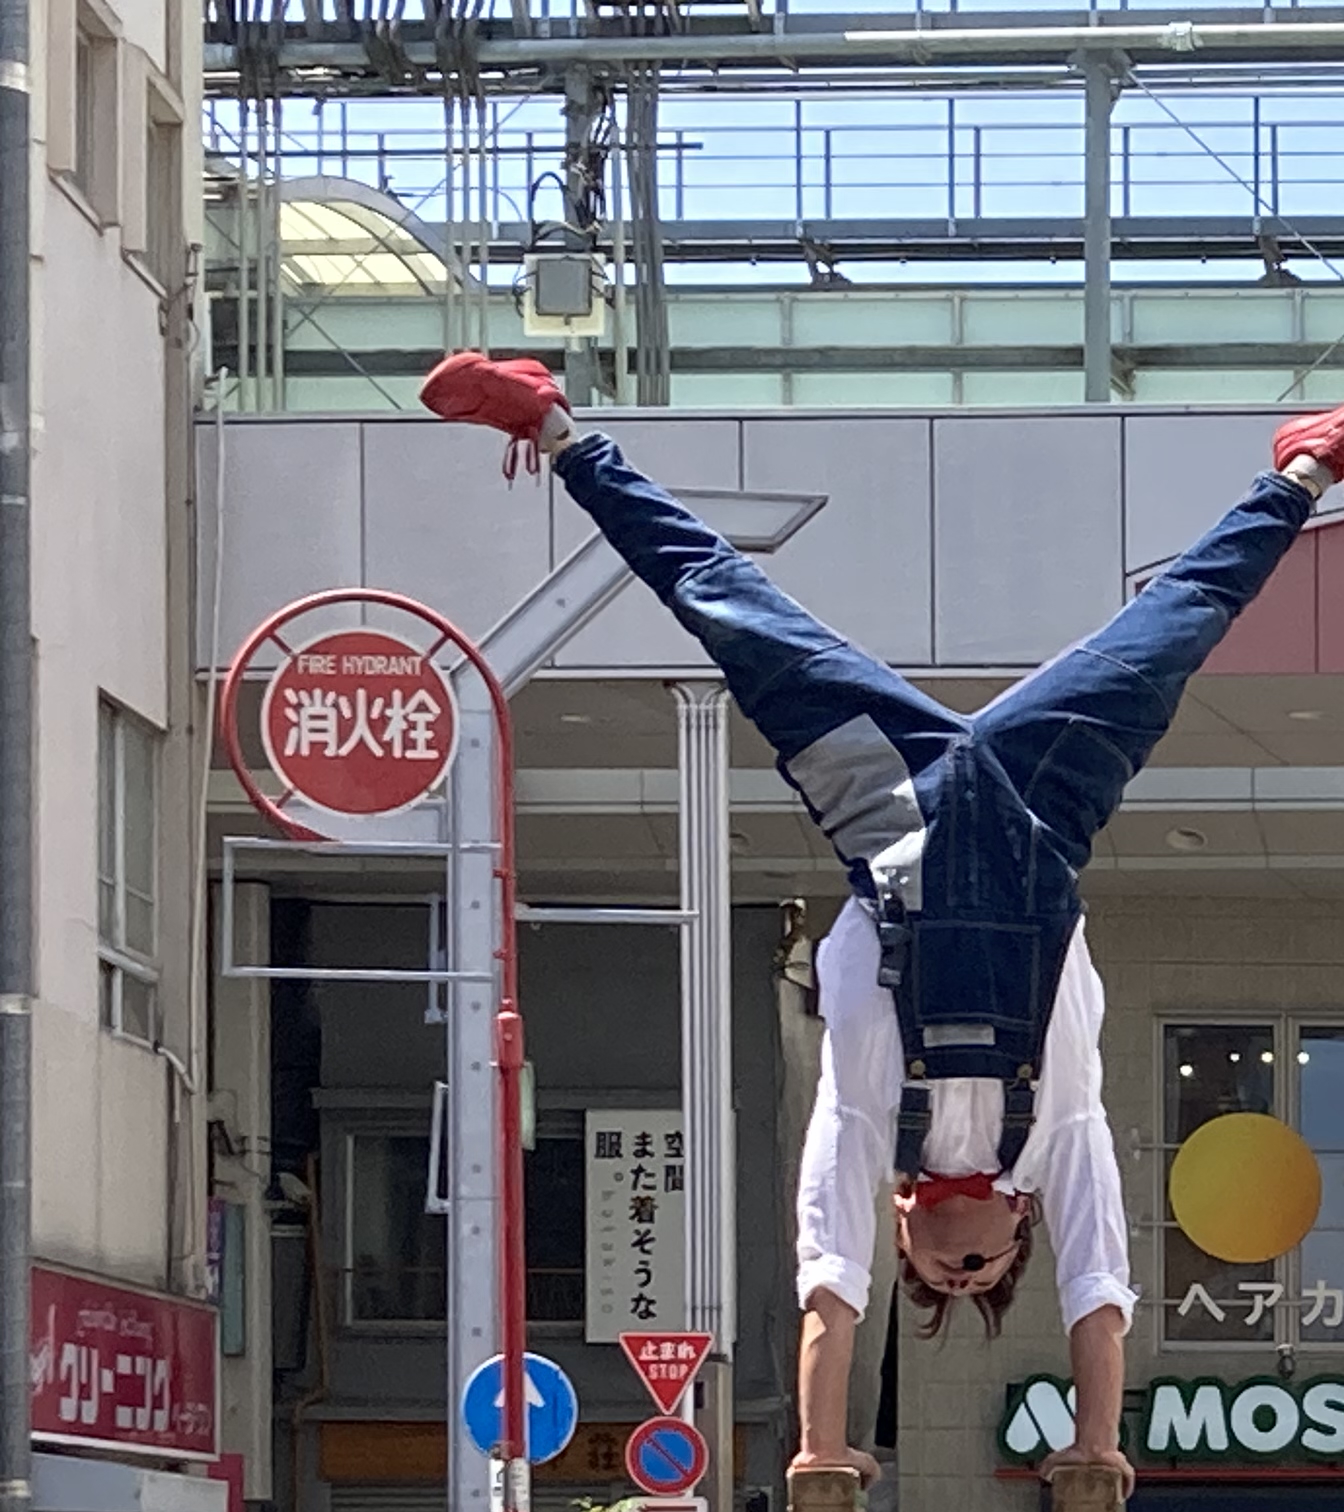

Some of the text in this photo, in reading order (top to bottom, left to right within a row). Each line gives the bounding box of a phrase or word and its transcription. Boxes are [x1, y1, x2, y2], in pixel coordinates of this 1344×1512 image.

[297, 655, 423, 676] FIRE HYDRANT
[283, 687, 442, 760] 消火栓
[628, 1131, 659, 1321] また着そうな
[638, 1340, 697, 1361] 止まれ
[648, 1363, 690, 1380] STOP
